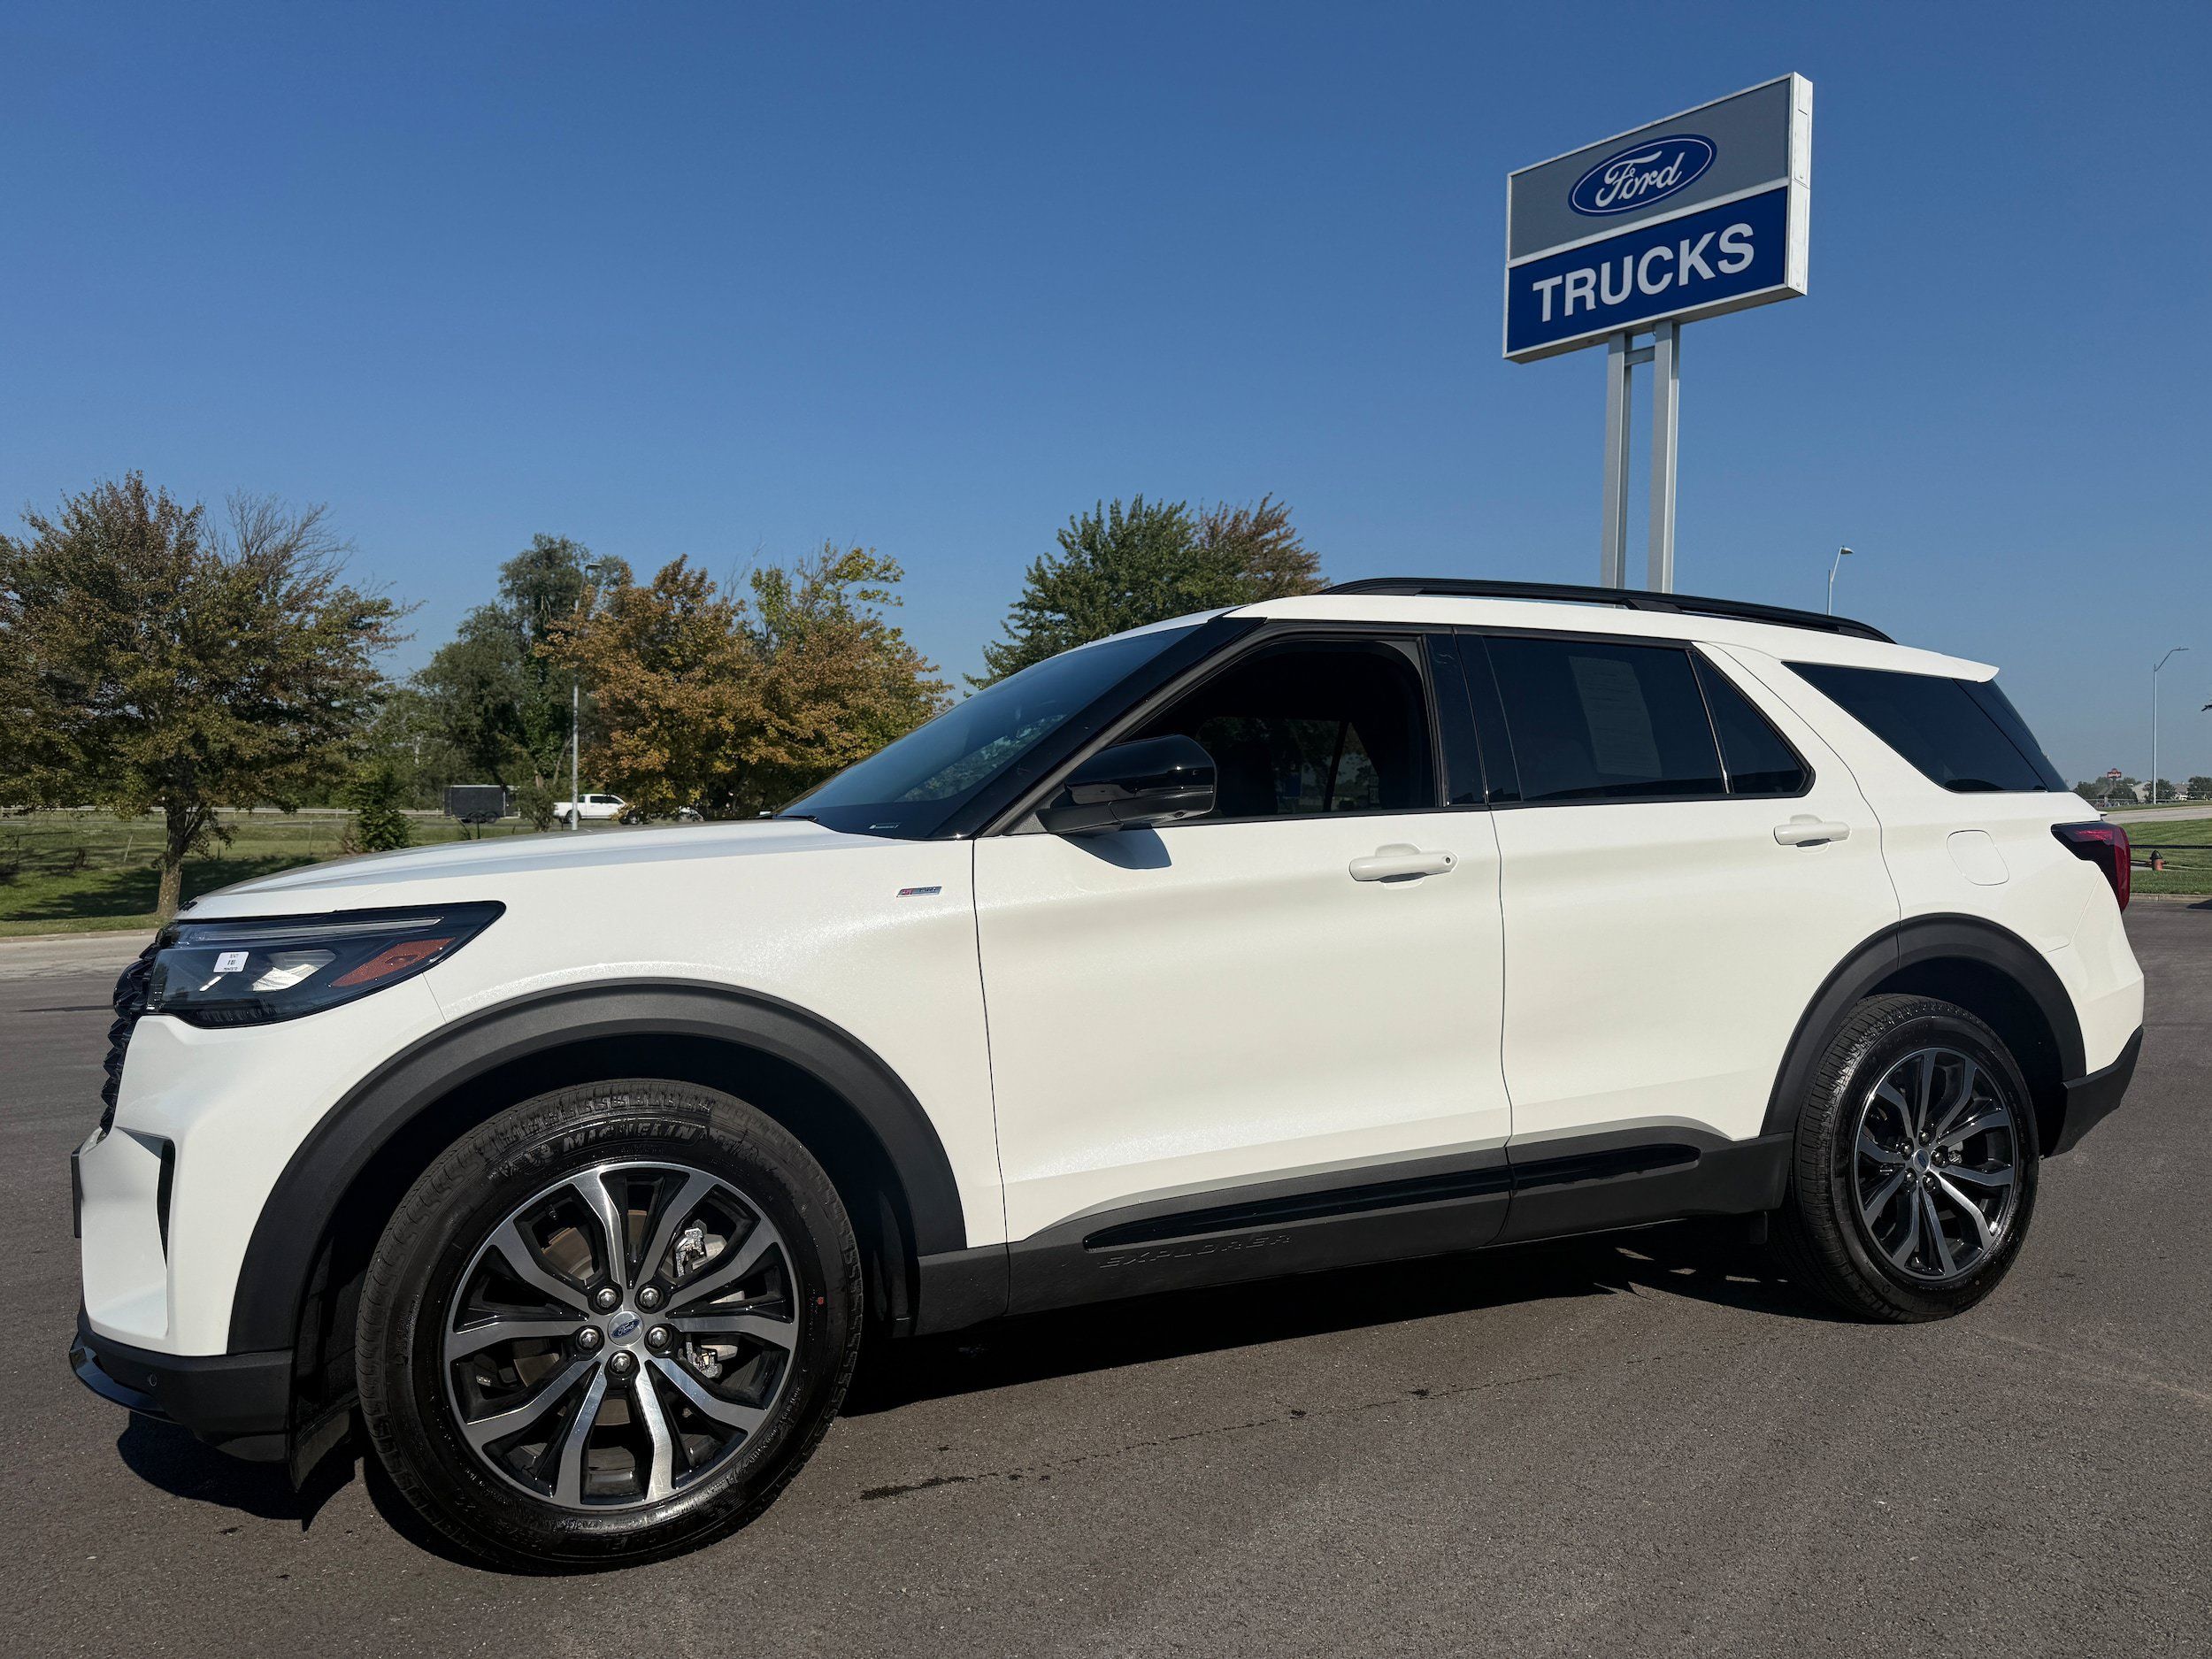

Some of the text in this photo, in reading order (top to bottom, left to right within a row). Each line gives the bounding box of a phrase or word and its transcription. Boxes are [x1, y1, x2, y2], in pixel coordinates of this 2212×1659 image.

[1595, 151, 1685, 207] Ford
[1532, 223, 1755, 322] TRUCKS
[1099, 1234, 1291, 1269] EXPLORER
